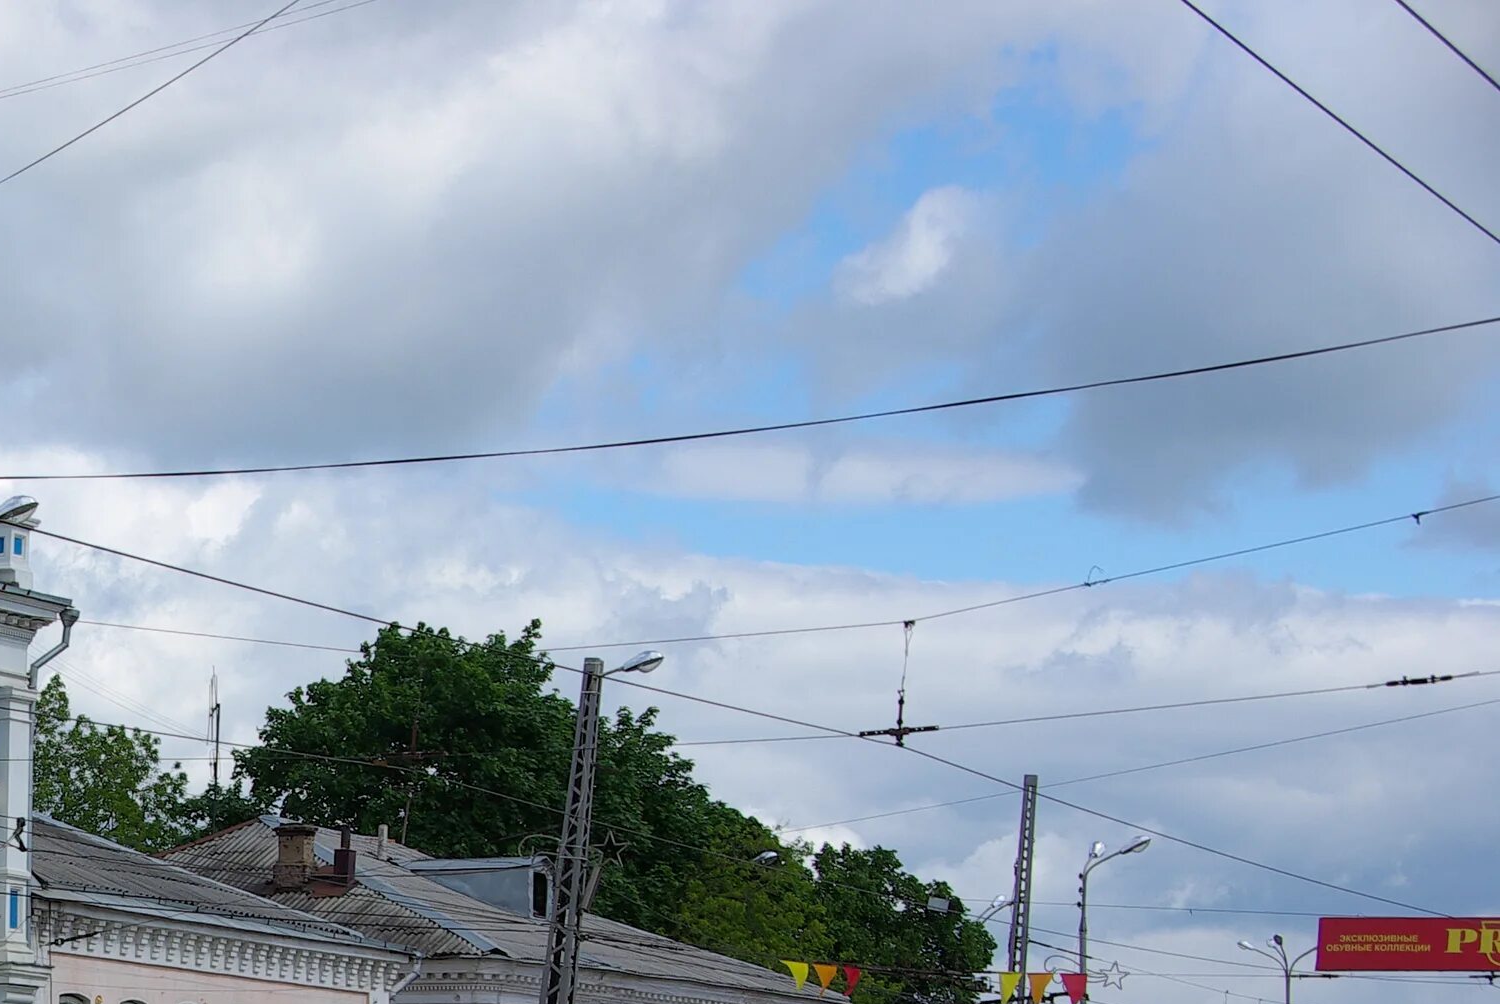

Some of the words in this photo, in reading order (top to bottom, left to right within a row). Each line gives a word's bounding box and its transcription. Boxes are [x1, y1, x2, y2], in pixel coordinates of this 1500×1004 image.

[1339, 934, 1419, 943] ЭКСКЛЮЗИВНЫЕ
[1326, 943, 1372, 953] ОБУВНЫЕ
[1374, 943, 1431, 953] КОЛЛЕКЦИИ
